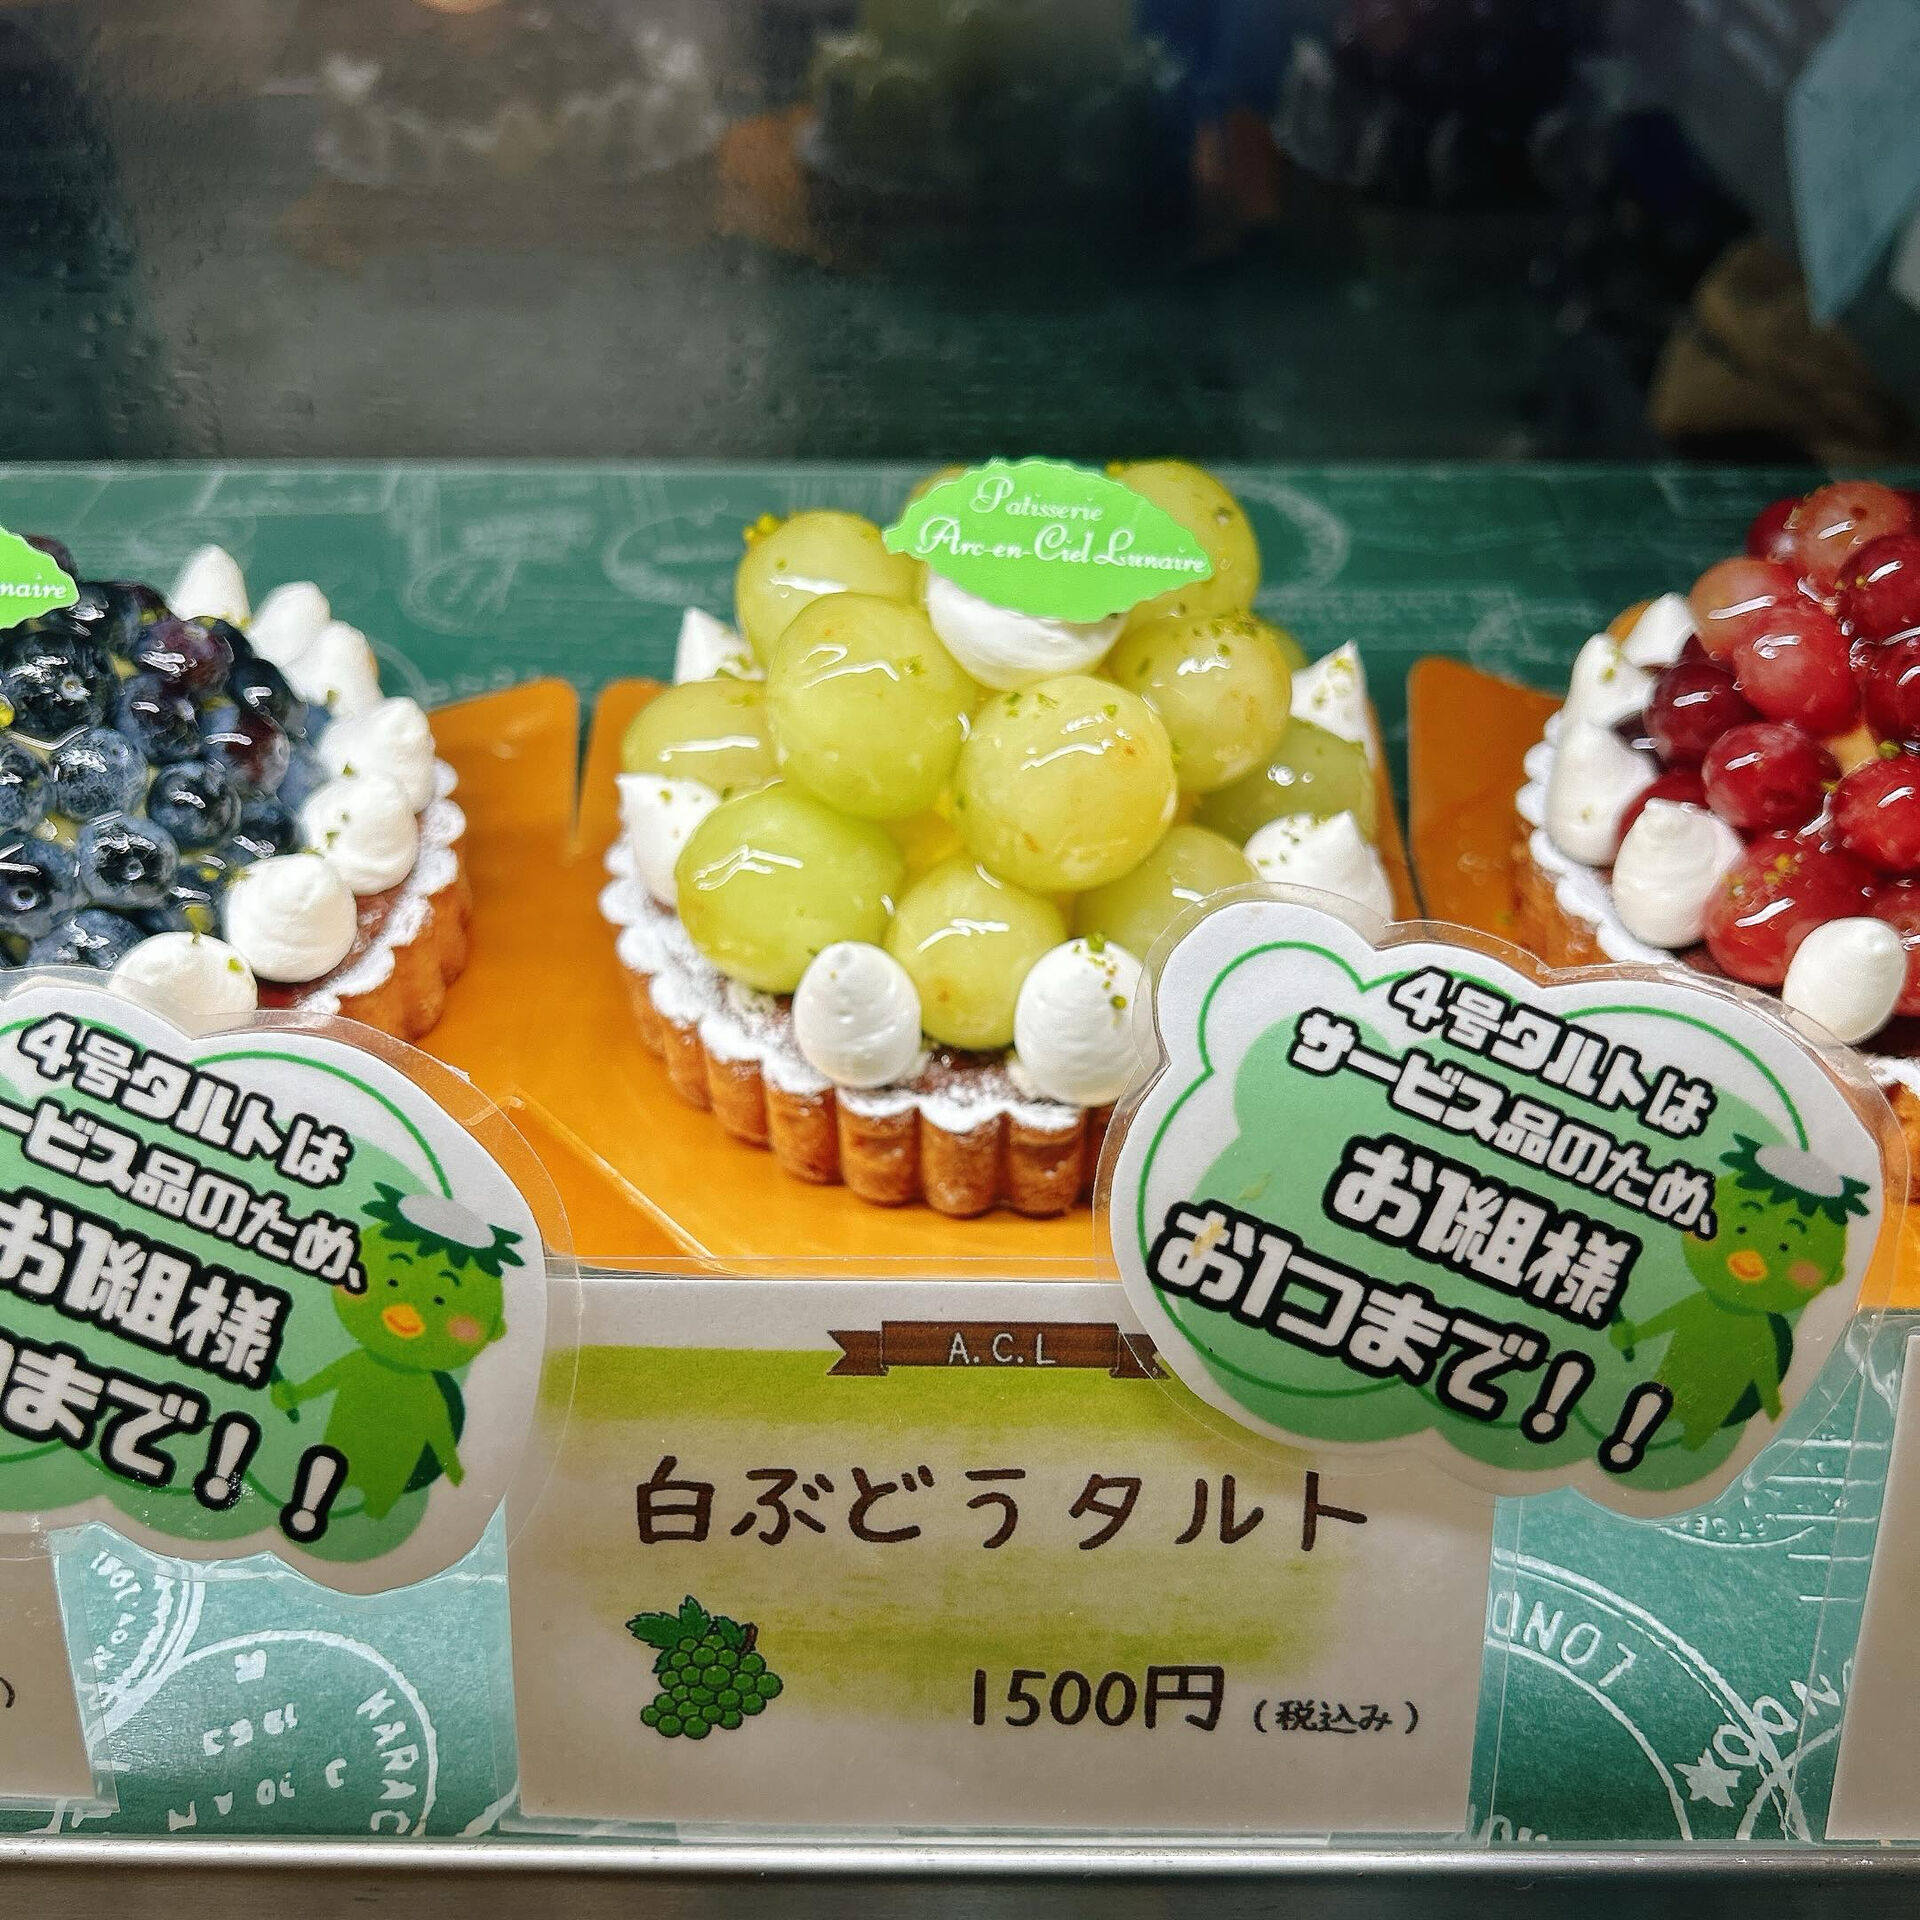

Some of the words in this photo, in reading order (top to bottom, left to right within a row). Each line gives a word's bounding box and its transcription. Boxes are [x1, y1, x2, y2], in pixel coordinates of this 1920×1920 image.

[914, 514, 1094, 565] Arc-en-Ciel
[1092, 526, 1207, 574] Lunaire
[969, 475, 1103, 521] Patisserie
[18, 1013, 352, 1187] 4号タルトは
[1288, 1008, 1716, 1237] サービス品のため、
[1389, 966, 1716, 1138] 4号タルトは
[1328, 1138, 1638, 1326] お1組様
[0, 1332, 343, 1537] まで！！
[636, 1454, 1368, 1551] 白ぶどうタルト
[973, 1664, 1226, 1732] 1500円
[1253, 1698, 1420, 1735] （税込み）
